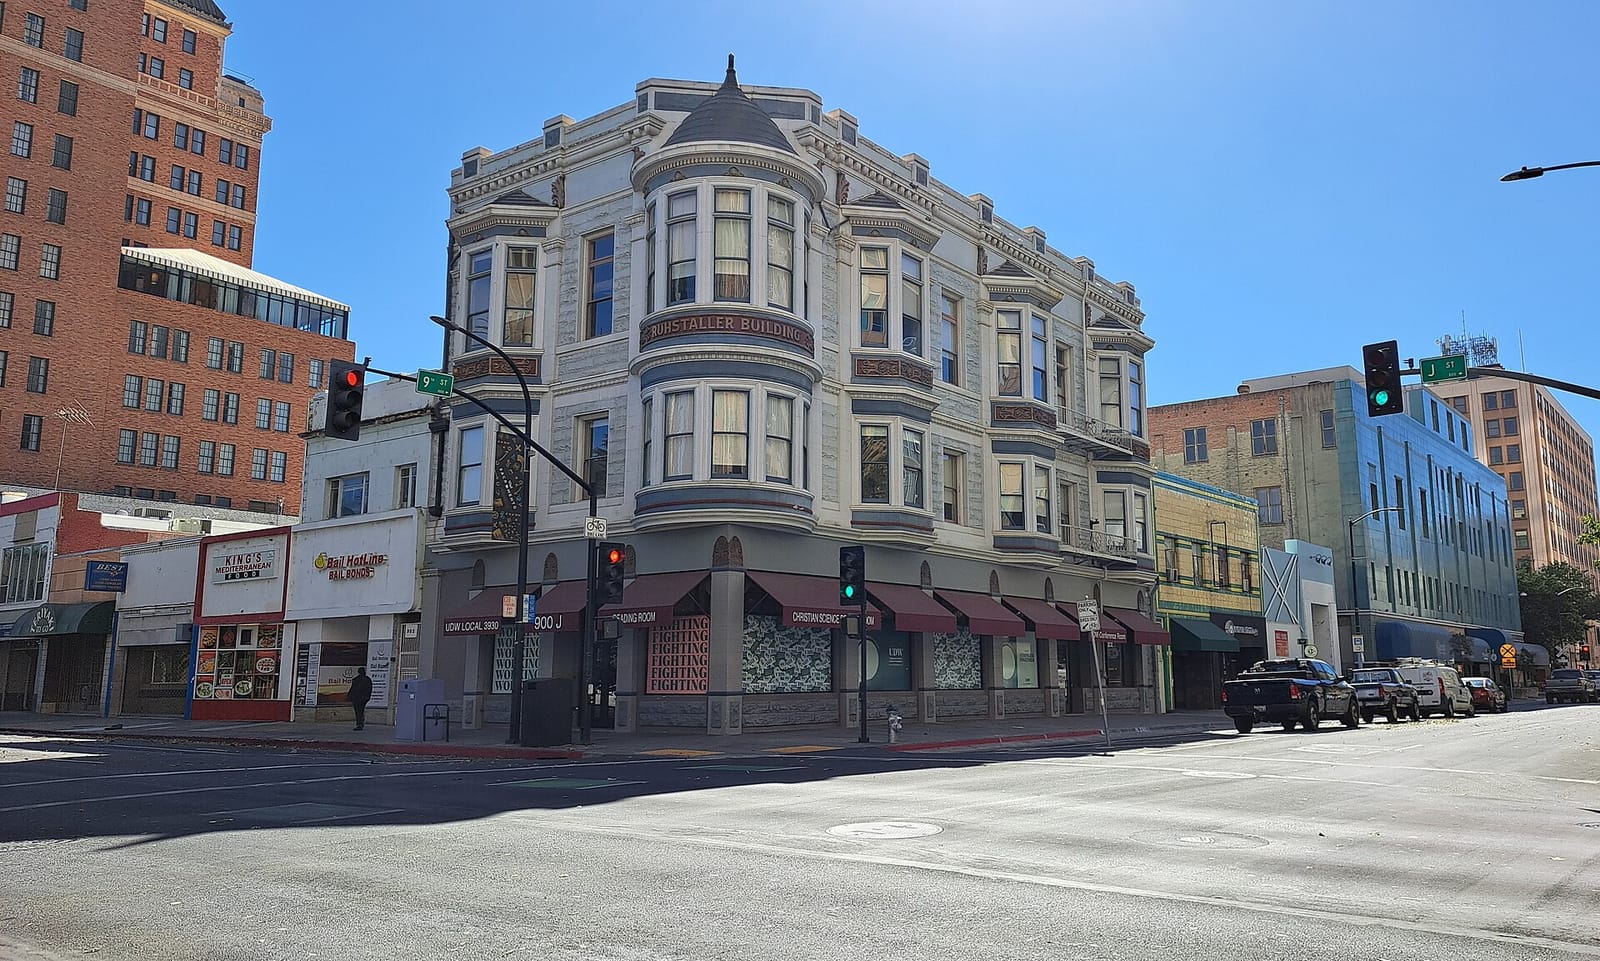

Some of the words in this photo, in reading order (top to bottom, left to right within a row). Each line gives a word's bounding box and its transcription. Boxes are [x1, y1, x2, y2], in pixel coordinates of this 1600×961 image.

[651, 317, 735, 339] RUHSTALLER
[740, 318, 801, 341] BUILDING
[1427, 363, 1435, 376] J
[1445, 361, 1455, 369] ST
[225, 552, 262, 566] KING'S
[327, 555, 345, 568] Bail
[346, 552, 384, 567] HotLine
[96, 563, 125, 571] BEST
[215, 562, 272, 574] MEDITERRANEAN
[227, 571, 257, 579] FOOD
[328, 570, 345, 580] BAIL
[346, 567, 370, 579] BONDS
[534, 616, 553, 630] 900
[555, 614, 562, 629] J
[638, 611, 656, 622] ROOM
[792, 611, 819, 623] CHRISTIAN
[819, 613, 840, 624] SCIENCE
[445, 622, 460, 631] UDW
[461, 622, 482, 631] LOCAL
[483, 621, 499, 630] 3930
[652, 630, 708, 642] FIGHTING
[652, 642, 708, 654] FIGHTING
[652, 654, 707, 666] FIGHTING
[651, 667, 707, 678] FIGHTING
[651, 679, 707, 690] FIGHTING
